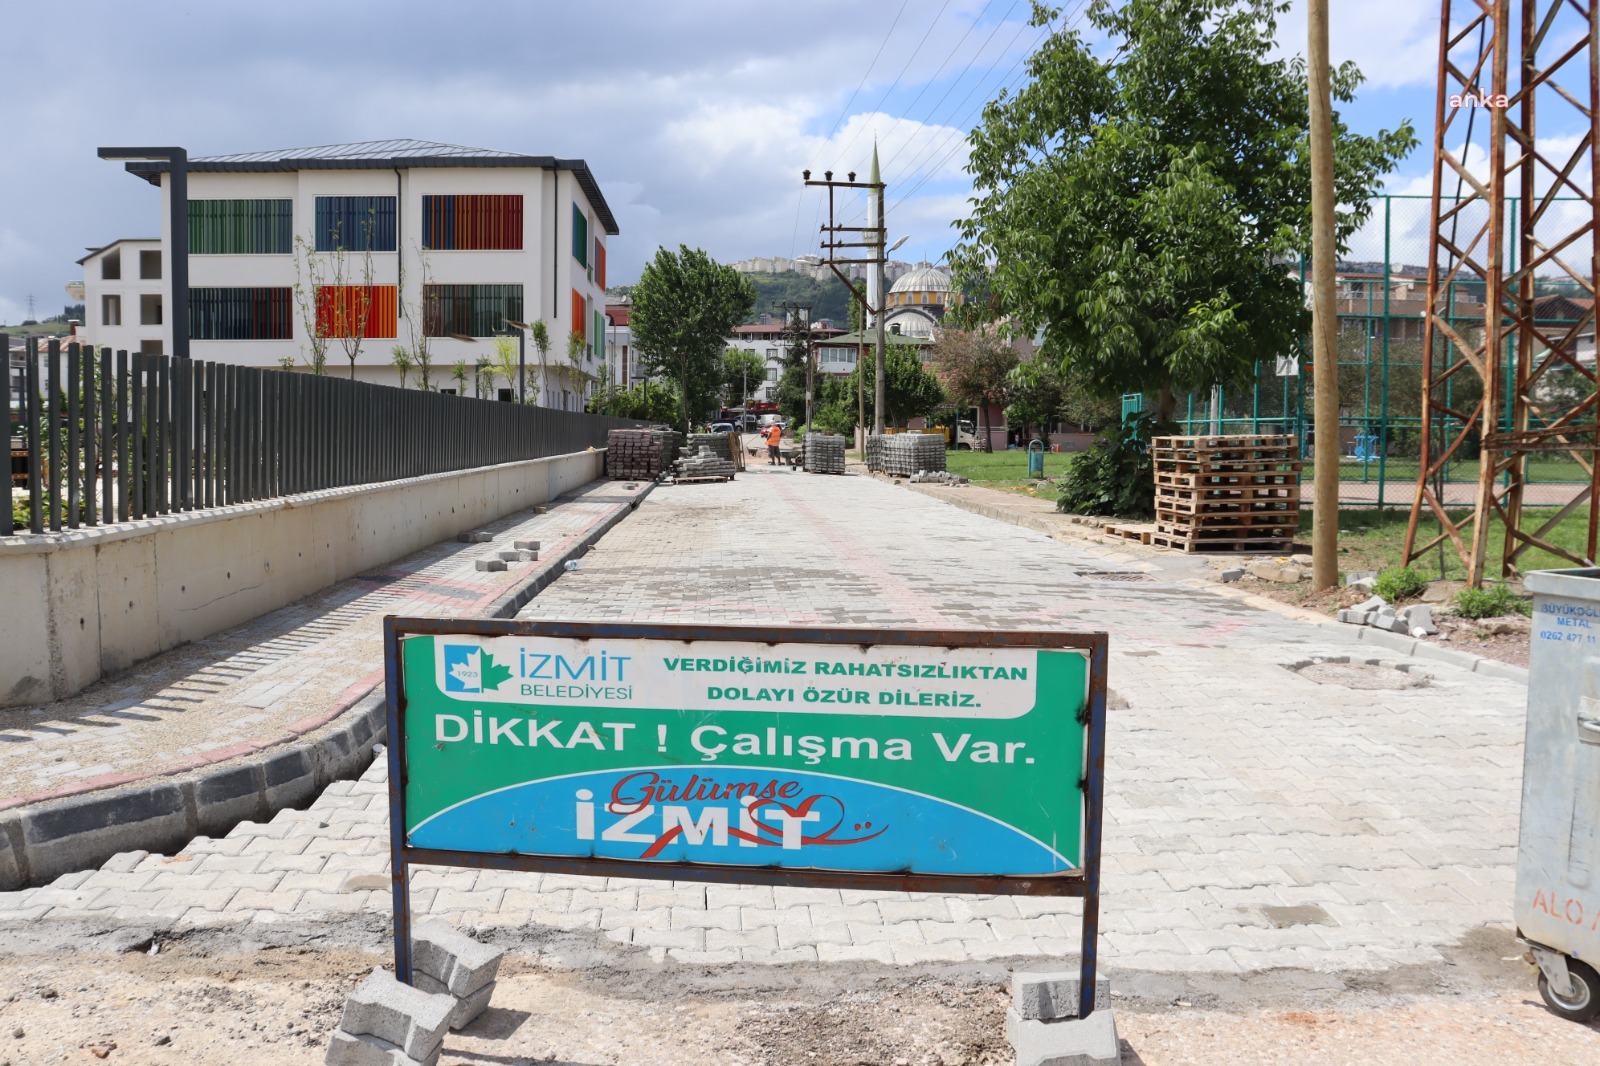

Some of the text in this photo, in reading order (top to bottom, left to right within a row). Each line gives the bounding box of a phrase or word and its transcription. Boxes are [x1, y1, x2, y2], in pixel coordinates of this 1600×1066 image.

[1557, 616, 1593, 629] METAL
[1540, 630, 1563, 641] 0262
[457, 670, 478, 678] 1923
[520, 647, 632, 682] İZMİT
[663, 656, 1028, 681] VERDİĞİMİZ RAHATSIZLIKTAN
[520, 683, 633, 700] BELEDİYESİ
[707, 686, 982, 708] DOLAYI ÖZÜR DİLERİZ.
[435, 709, 1035, 765] DİKKAT ! Çalışma Var.
[608, 771, 804, 815] Gülümse
[1532, 887, 1584, 926] ALO
